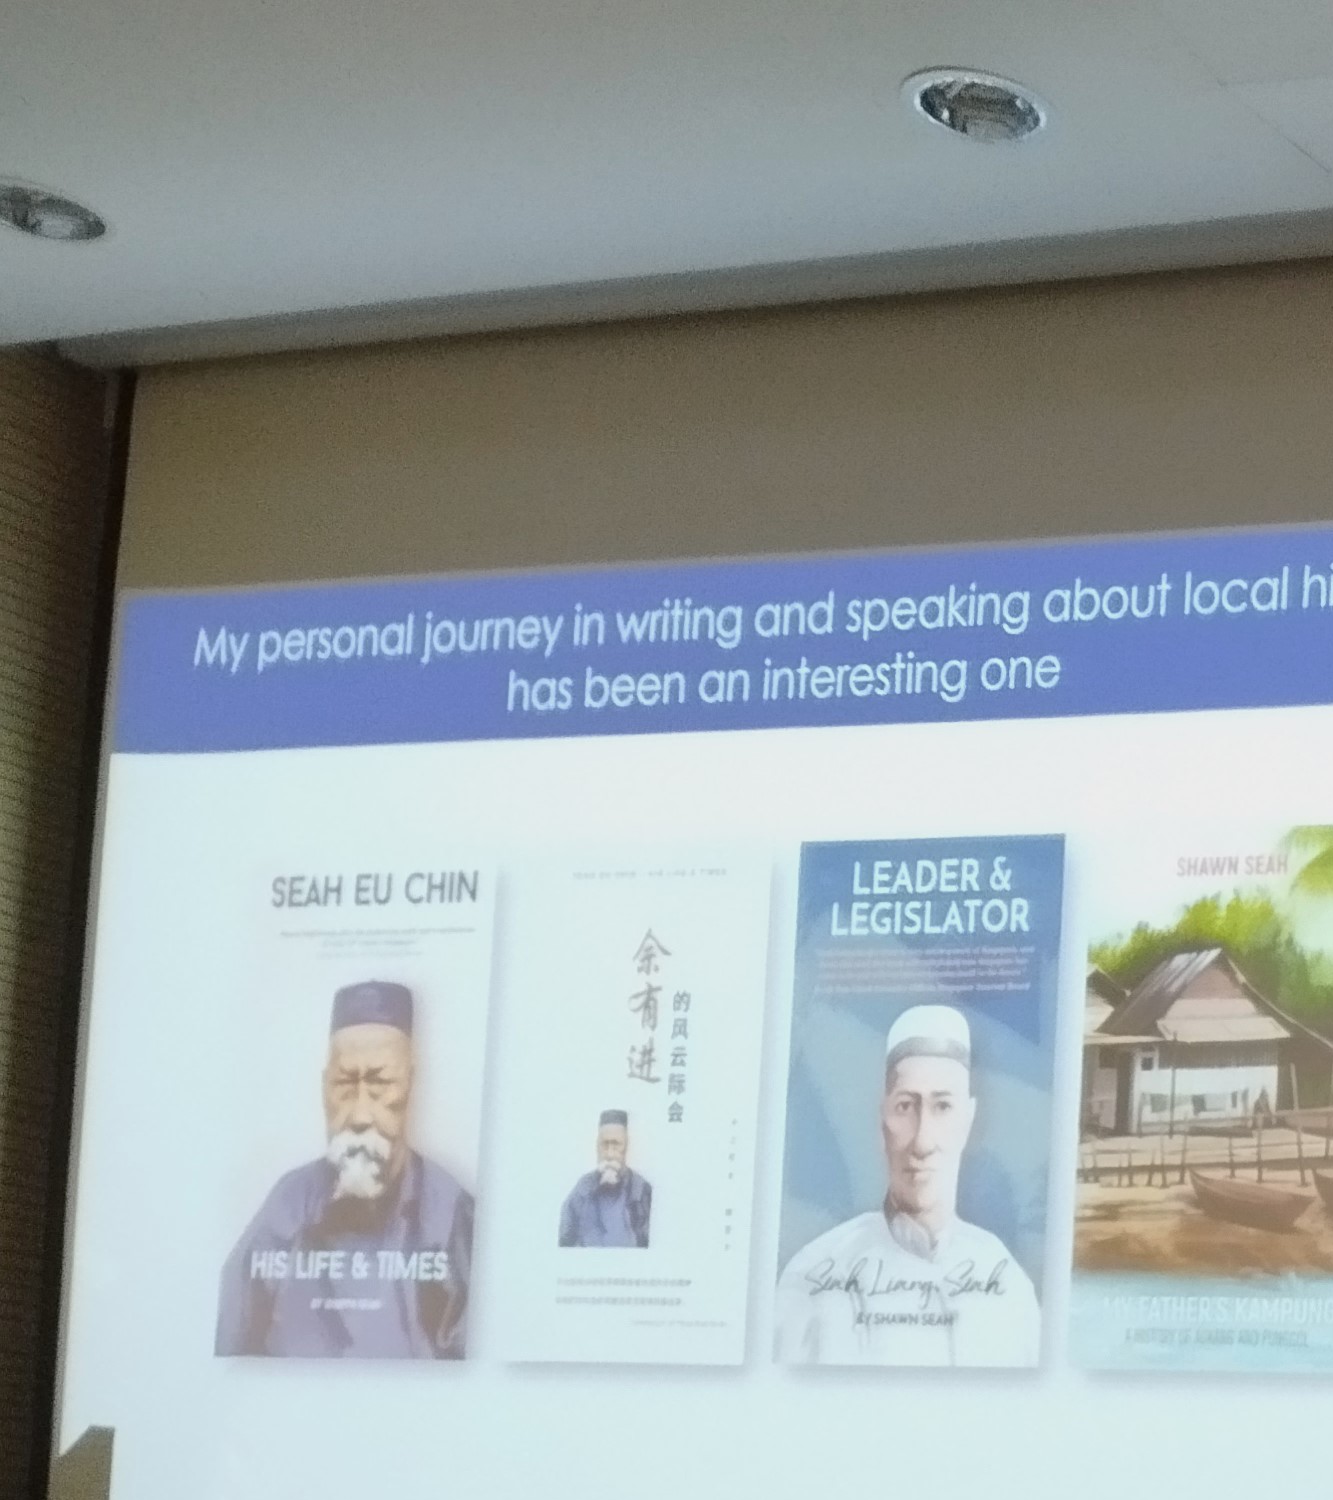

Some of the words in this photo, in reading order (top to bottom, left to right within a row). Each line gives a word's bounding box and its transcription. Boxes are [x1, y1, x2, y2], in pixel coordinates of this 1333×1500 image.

[194, 627, 248, 676] My
[257, 612, 415, 675] personal
[421, 610, 564, 665] journey
[574, 602, 603, 647] in
[615, 598, 742, 650] writing
[755, 590, 834, 638] and
[846, 582, 1029, 641] speaking
[1043, 572, 1171, 624] about
[1184, 566, 1289, 614] local
[507, 670, 572, 711] has
[584, 666, 685, 710] been
[698, 667, 750, 704] an
[761, 651, 967, 703] interesting
[980, 653, 1061, 691] one
[853, 857, 980, 895] LEADER
[989, 856, 1013, 892] &
[1176, 855, 1239, 878] SHAWN
[1243, 853, 1289, 877] SEAH
[271, 874, 344, 909] SEAH
[354, 872, 393, 906] EU
[404, 869, 479, 905] CHIN
[831, 898, 1031, 936] LEGISLATOR
[667, 990, 692, 1123] 的风云际会
[251, 1249, 289, 1280] HIS
[295, 1250, 348, 1280] LIFE
[351, 1251, 369, 1280] &
[376, 1250, 451, 1281] TIMES
[874, 1311, 920, 1326] SHAWN
[921, 1312, 957, 1327] SEAH
